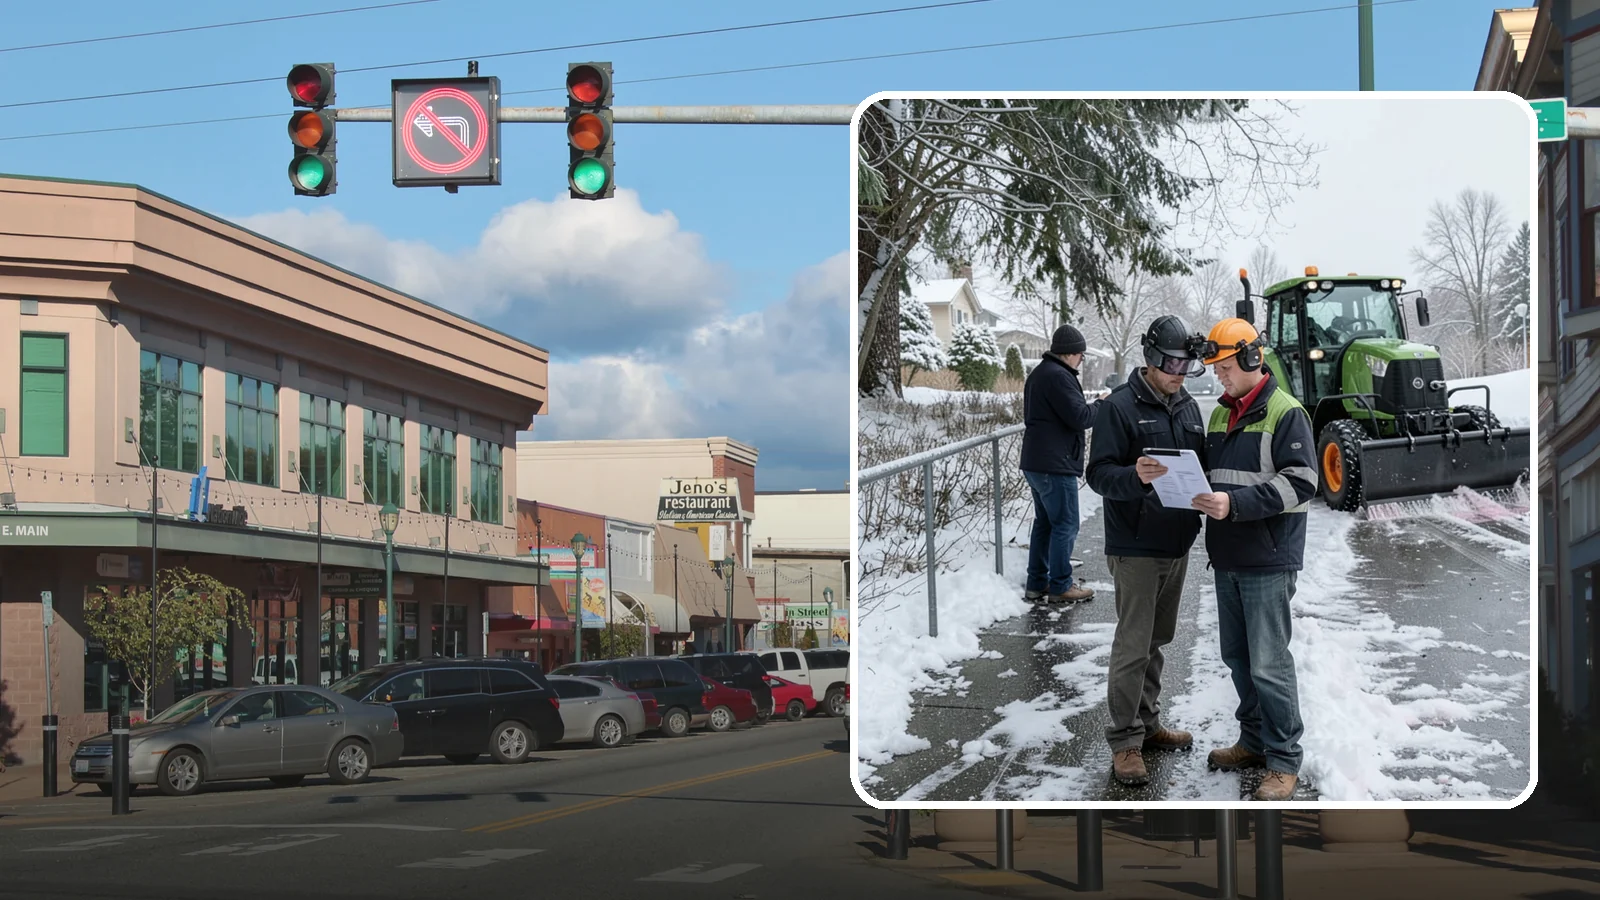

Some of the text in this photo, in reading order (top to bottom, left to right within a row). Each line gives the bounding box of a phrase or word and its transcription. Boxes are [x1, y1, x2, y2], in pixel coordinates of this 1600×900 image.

[669, 480, 728, 495] Jeno's
[665, 496, 731, 509] restaurant
[686, 510, 714, 519] American
[715, 509, 737, 519] Cuisine
[2, 525, 49, 536] E. MAIN
[797, 607, 828, 617] Street
